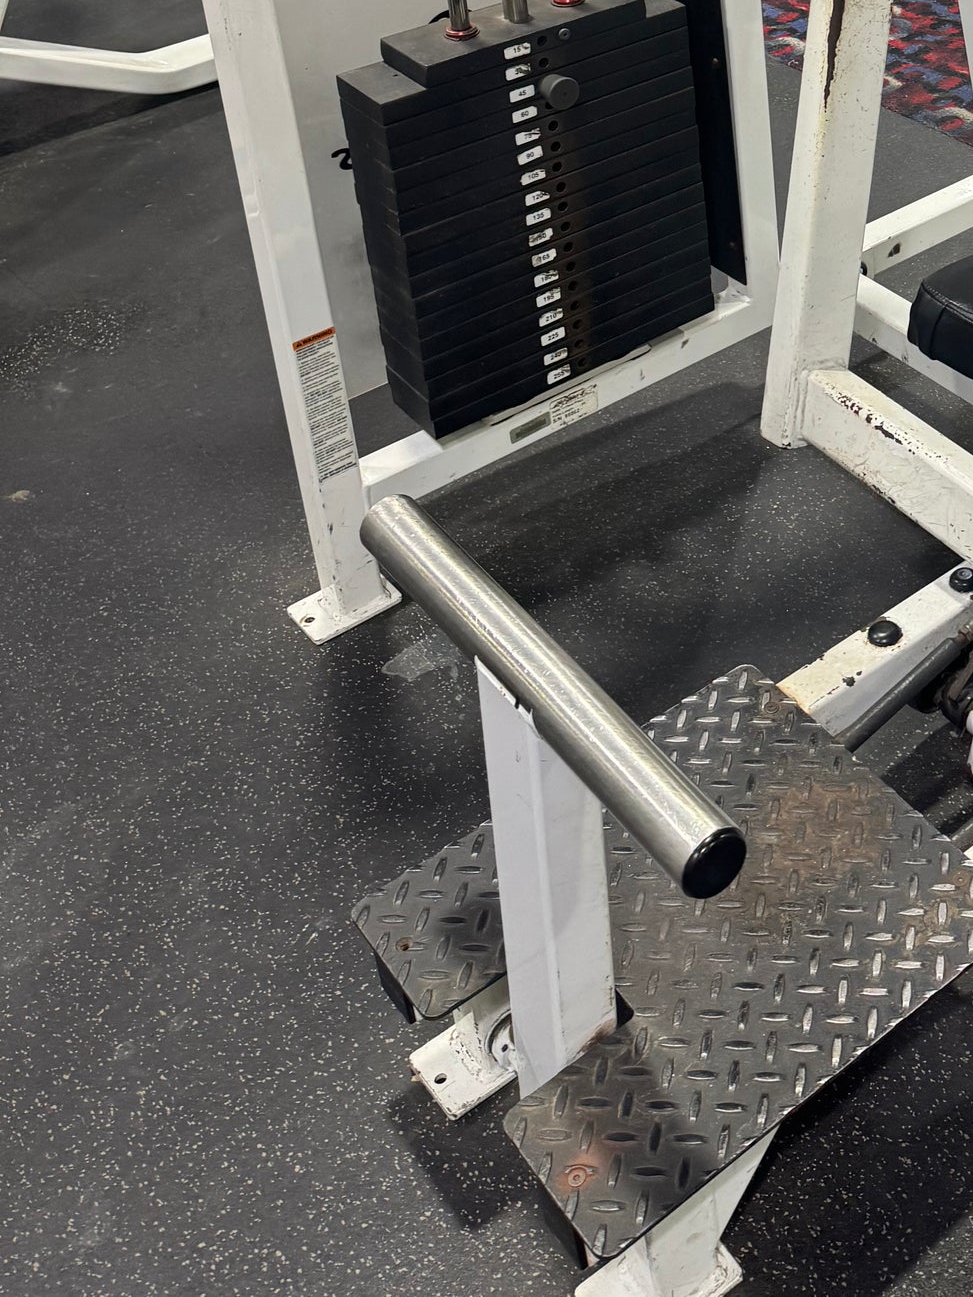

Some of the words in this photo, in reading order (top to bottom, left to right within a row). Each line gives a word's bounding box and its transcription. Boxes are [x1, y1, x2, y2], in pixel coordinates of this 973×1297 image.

[513, 45, 522, 54] 15
[532, 211, 545, 221] 135
[547, 331, 560, 342] 225
